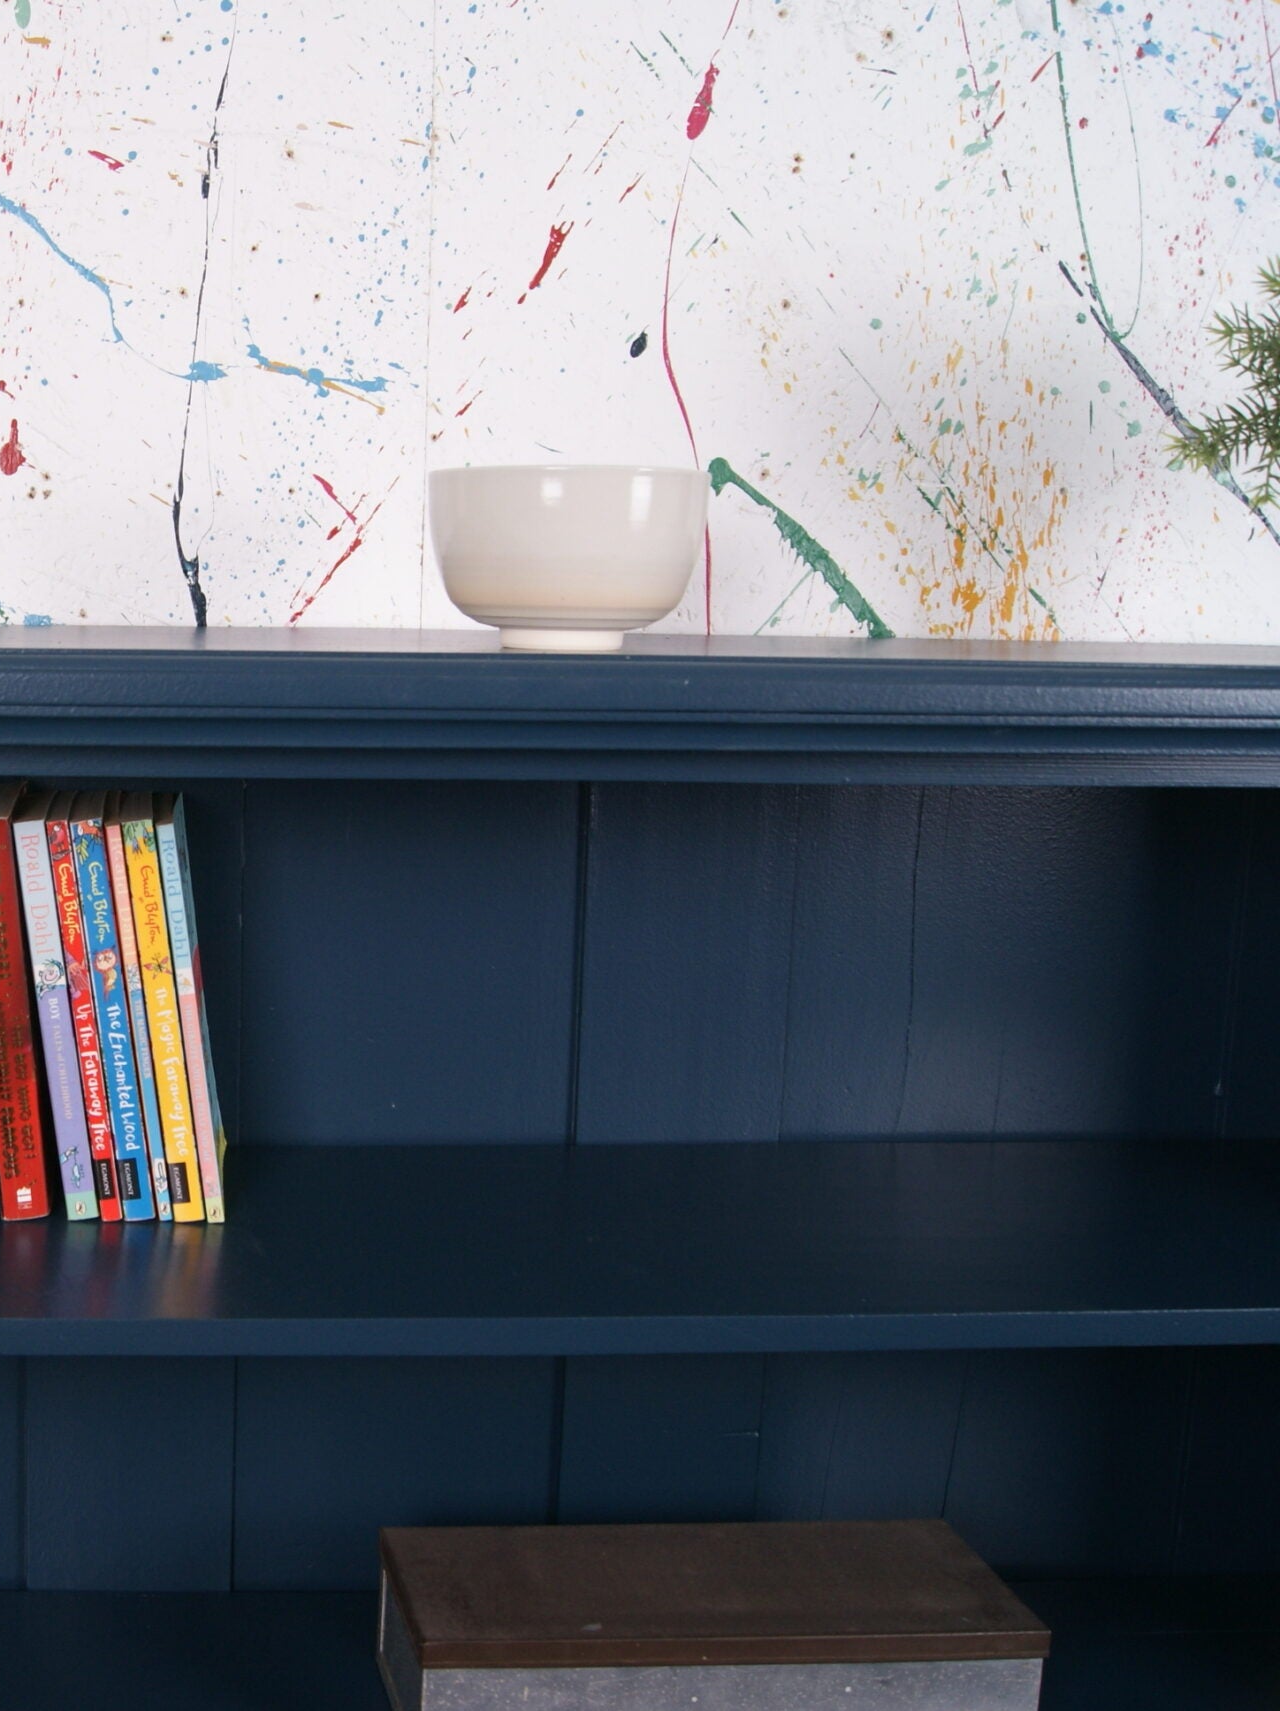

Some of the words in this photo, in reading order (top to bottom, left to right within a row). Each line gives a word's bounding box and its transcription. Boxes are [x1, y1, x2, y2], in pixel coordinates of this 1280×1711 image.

[20, 834, 46, 894] Roald
[58, 863, 73, 898] Enid
[88, 861, 103, 896] Enid
[140, 865, 155, 898] Enid
[162, 839, 181, 897] Roald
[30, 904, 55, 955] Dahl
[64, 901, 80, 943] Blyton
[93, 899, 110, 944] Blyton
[144, 901, 161, 946] Blyton
[171, 908, 190, 959] Dahl
[48, 998, 61, 1020] BOY
[76, 1003, 92, 1021] Up
[155, 987, 168, 1006] The
[107, 1002, 122, 1028] The
[155, 1009, 175, 1053] Magic
[79, 1026, 93, 1047] The
[81, 1050, 102, 1117] Faraway
[108, 1031, 135, 1108] Enchanted
[161, 1056, 184, 1123] Faraway
[91, 1120, 109, 1151] Tree
[120, 1111, 141, 1152] Wood
[172, 1126, 189, 1157] Tree
[100, 1163, 111, 1196] EGMONT
[123, 1163, 134, 1196] EGMONT
[173, 1167, 183, 1200] EGMONT
